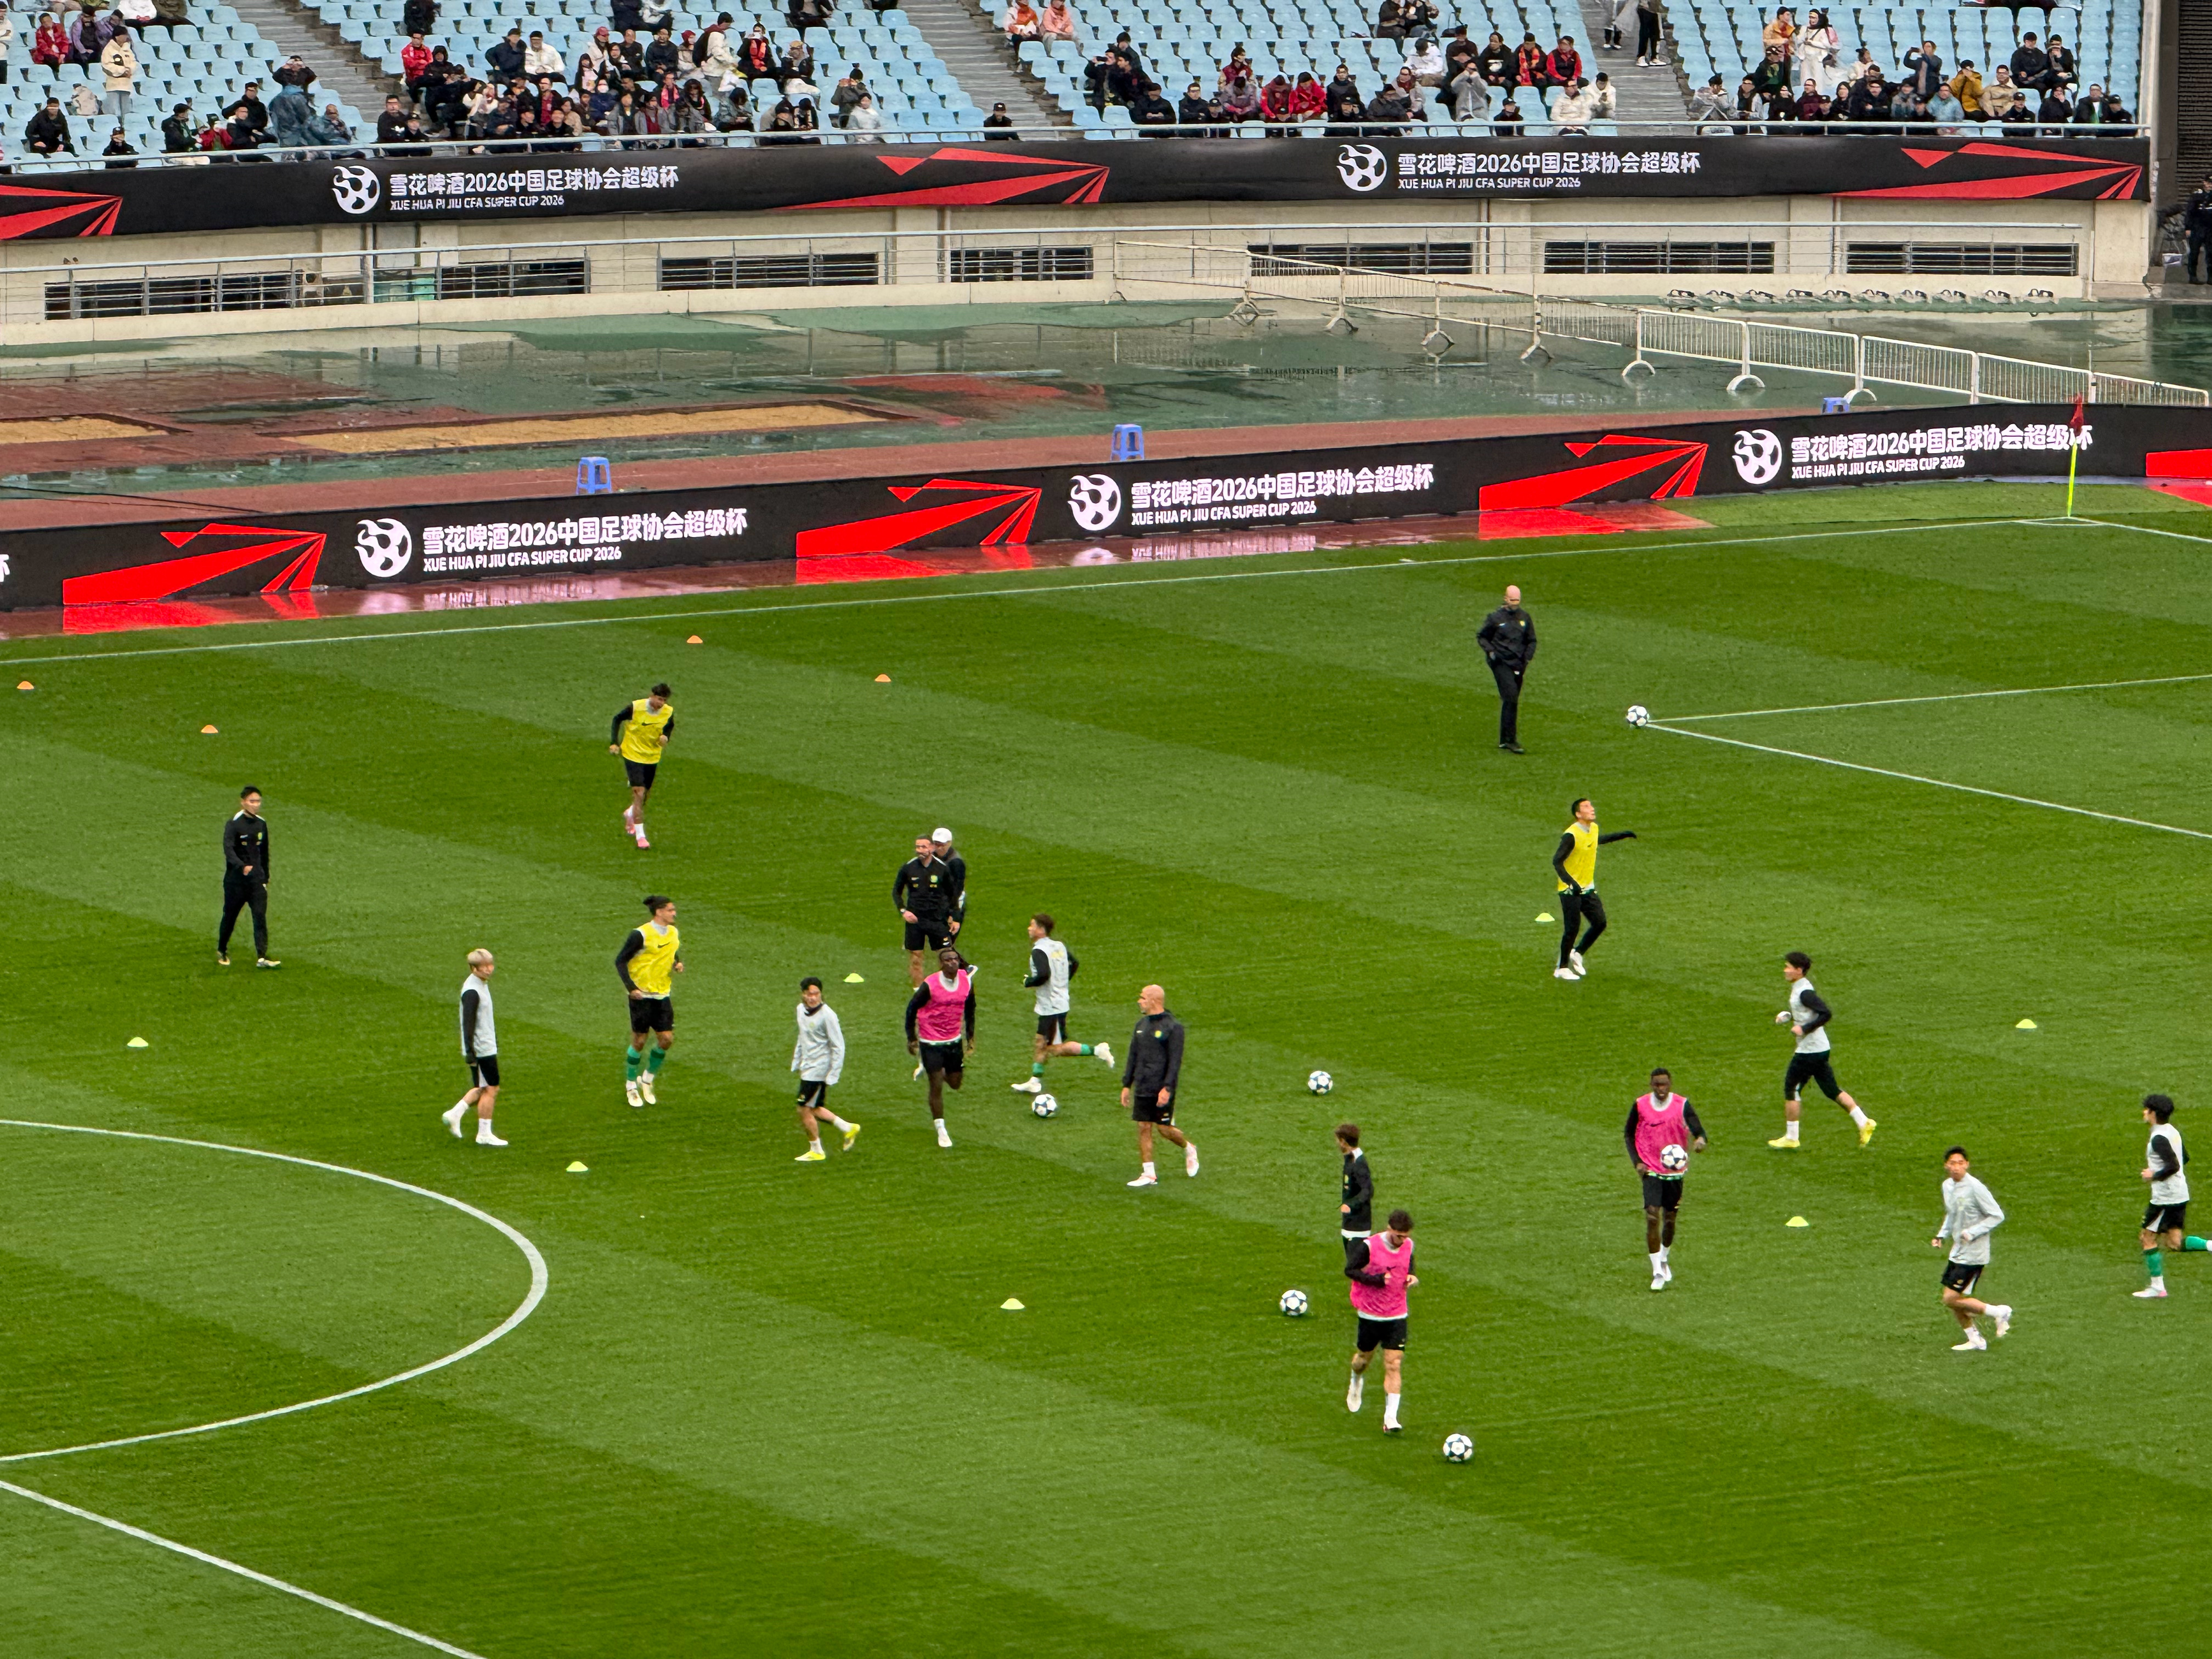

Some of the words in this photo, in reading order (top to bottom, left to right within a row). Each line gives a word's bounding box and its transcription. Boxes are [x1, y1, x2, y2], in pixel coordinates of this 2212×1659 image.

[1398, 151, 1700, 175] 雪花啤酒2026中国足球协会超级杯
[390, 166, 679, 196] 雪花啤酒2026中国足球协会超级杯
[1398, 179, 1418, 189] XUE
[1421, 178, 1443, 189] HUA
[1446, 178, 1455, 189] PI
[1458, 178, 1473, 189] JIU
[1475, 178, 1495, 189] CFA
[1497, 177, 1531, 188] SUPER
[1533, 177, 1553, 188] CUP
[1555, 177, 1581, 188] 2026
[390, 200, 410, 211] XUE
[411, 199, 434, 210] HUA
[436, 199, 445, 209] PI
[447, 198, 461, 209] JIU
[464, 197, 483, 208] CFA
[485, 196, 517, 208] SUPER
[519, 196, 539, 207] CUP
[1791, 424, 2093, 463] 雪花啤酒2026中国足球协会超级杯
[1792, 465, 1812, 479] XUE
[1814, 464, 1836, 478] HUA
[1837, 463, 1847, 476] PI
[1848, 462, 1864, 476] JIU
[1865, 460, 1885, 474] CFA
[1886, 458, 1918, 473] SUPER
[1919, 457, 1939, 471] CUP
[1940, 455, 1965, 470] 2026
[1131, 464, 1434, 508] 雪花啤酒2026中国足球协会超级杯
[1131, 511, 1154, 526] XUE
[1155, 510, 1179, 524] HUA
[1181, 509, 1190, 523] PI
[1193, 507, 1209, 522] JIU
[1211, 506, 1232, 521] CFA
[1232, 504, 1267, 520] SUPER
[1268, 502, 1289, 517] CUP
[1290, 500, 1317, 515] 2026
[423, 508, 748, 554] 雪花啤酒2026中国足球协会超级杯
[423, 556, 447, 572] XUE
[448, 555, 474, 571] HUA
[476, 554, 487, 568] PI
[488, 553, 506, 568] JIU
[509, 552, 530, 567] CFA
[531, 550, 567, 565] SUPER
[569, 548, 592, 562] CUP
[594, 546, 622, 561] 2026
